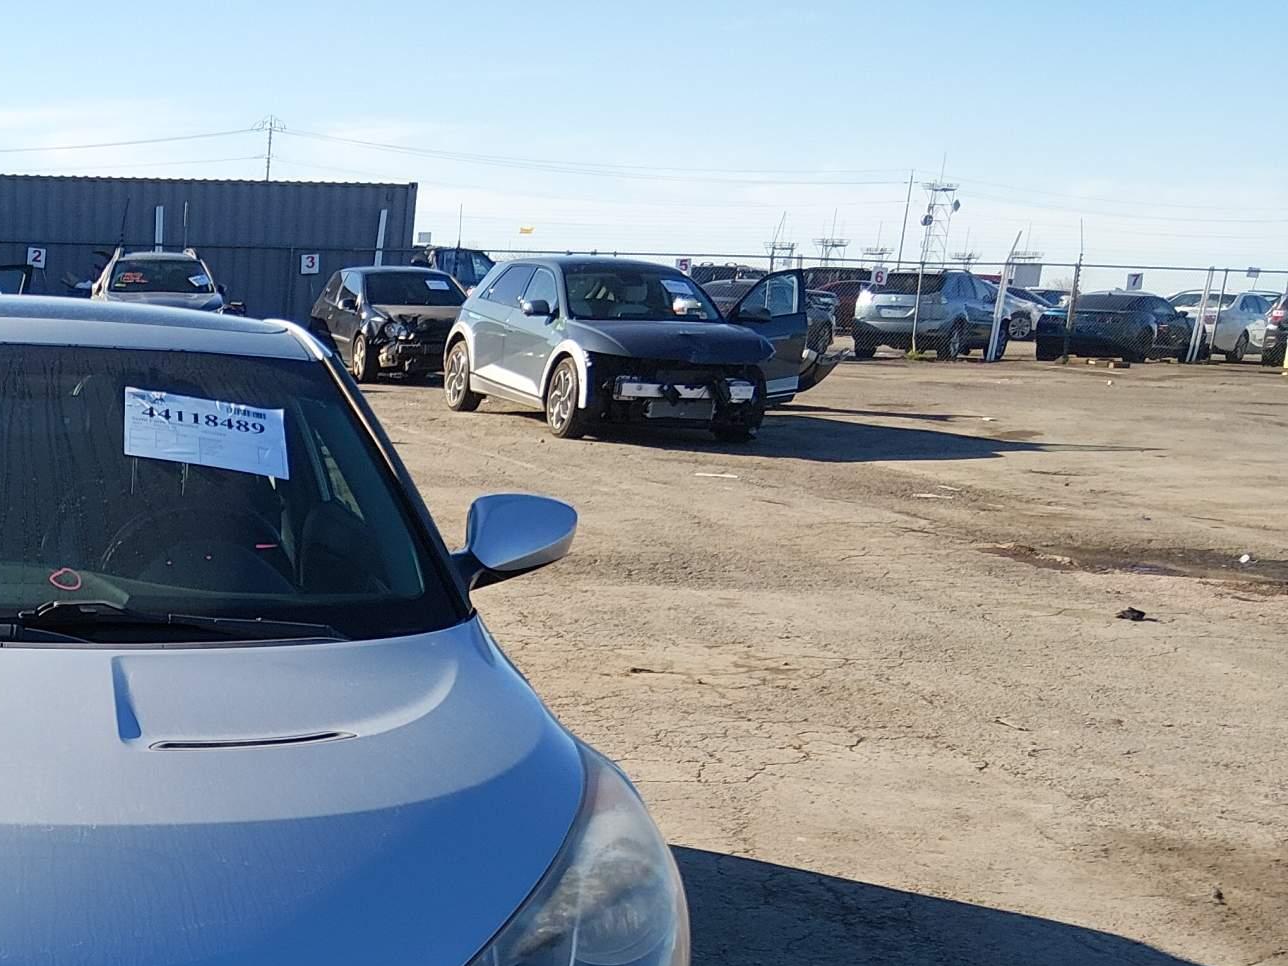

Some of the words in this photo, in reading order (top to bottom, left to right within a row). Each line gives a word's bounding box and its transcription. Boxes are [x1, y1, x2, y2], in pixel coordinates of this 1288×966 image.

[31, 249, 42, 262] 2
[305, 255, 315, 269] 3
[679, 259, 689, 272] 5
[875, 270, 884, 283] 6
[1131, 273, 1140, 287] 7
[141, 405, 265, 435] 44118489
